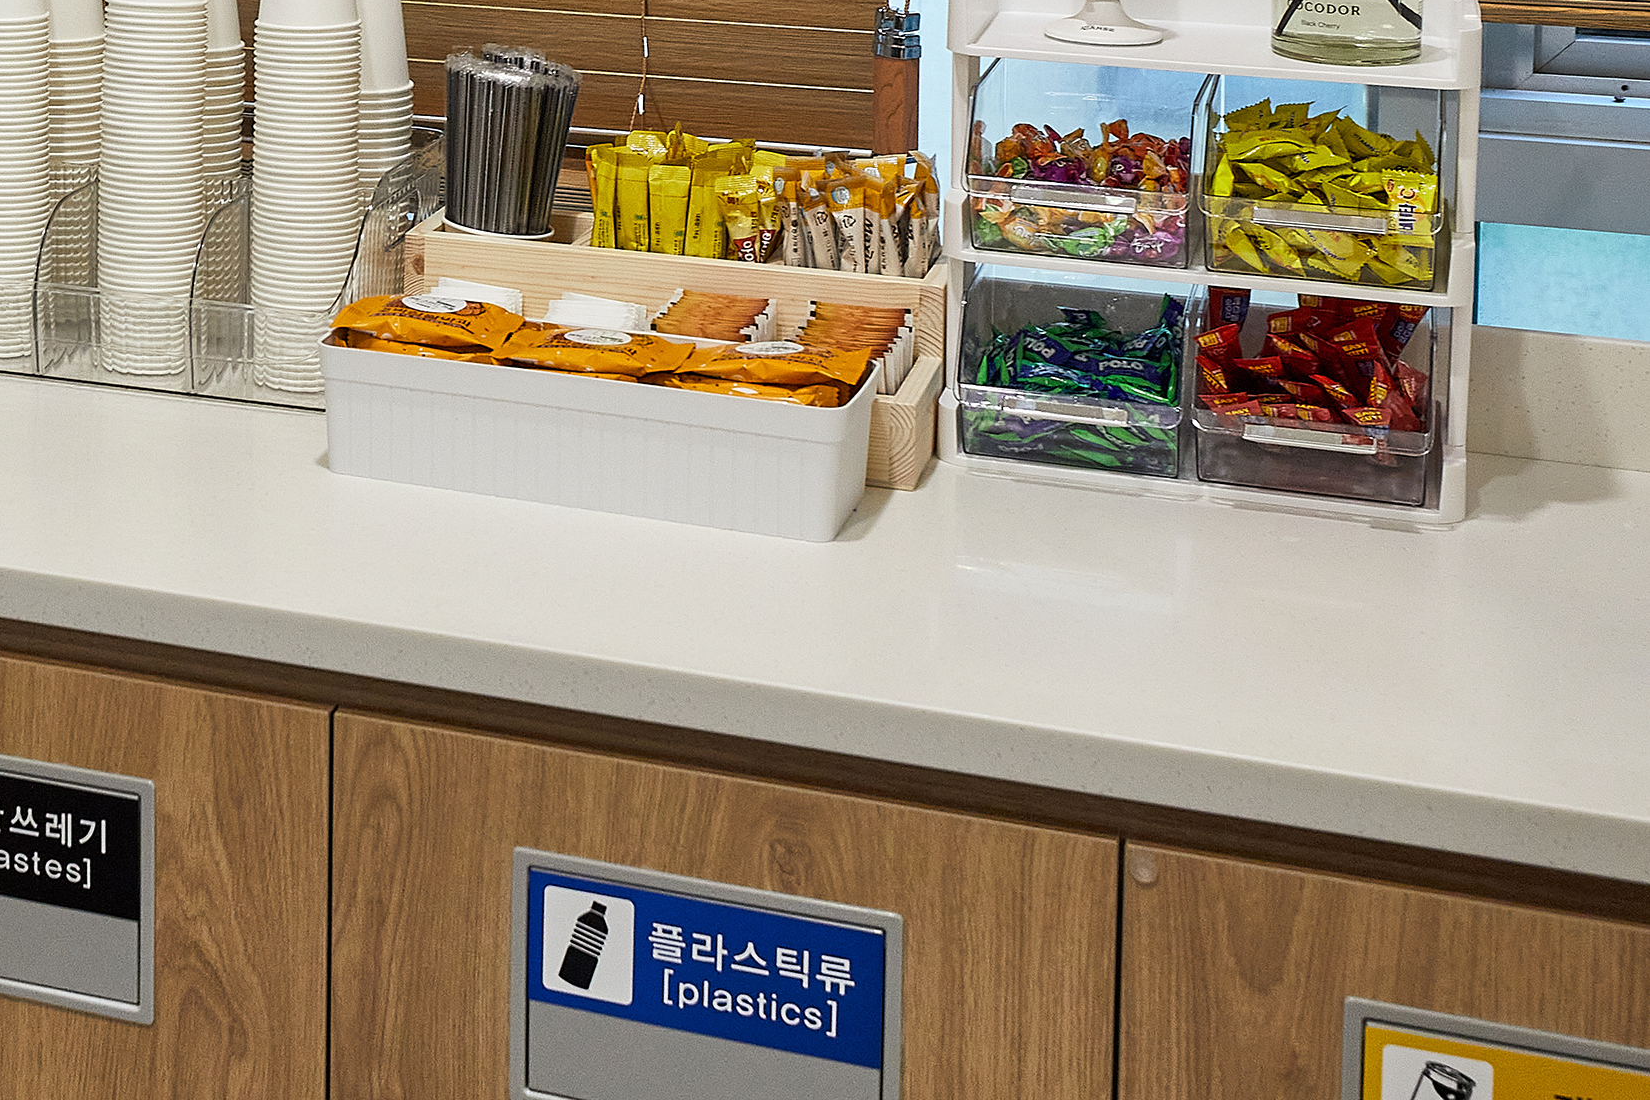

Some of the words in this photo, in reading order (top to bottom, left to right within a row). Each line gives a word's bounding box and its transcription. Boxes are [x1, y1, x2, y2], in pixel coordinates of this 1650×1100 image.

[1317, 20, 1341, 30] Cherry
[1099, 359, 1144, 371] POLO
[648, 922, 856, 996] 플라스틱류
[663, 968, 838, 1038] [plastics]
